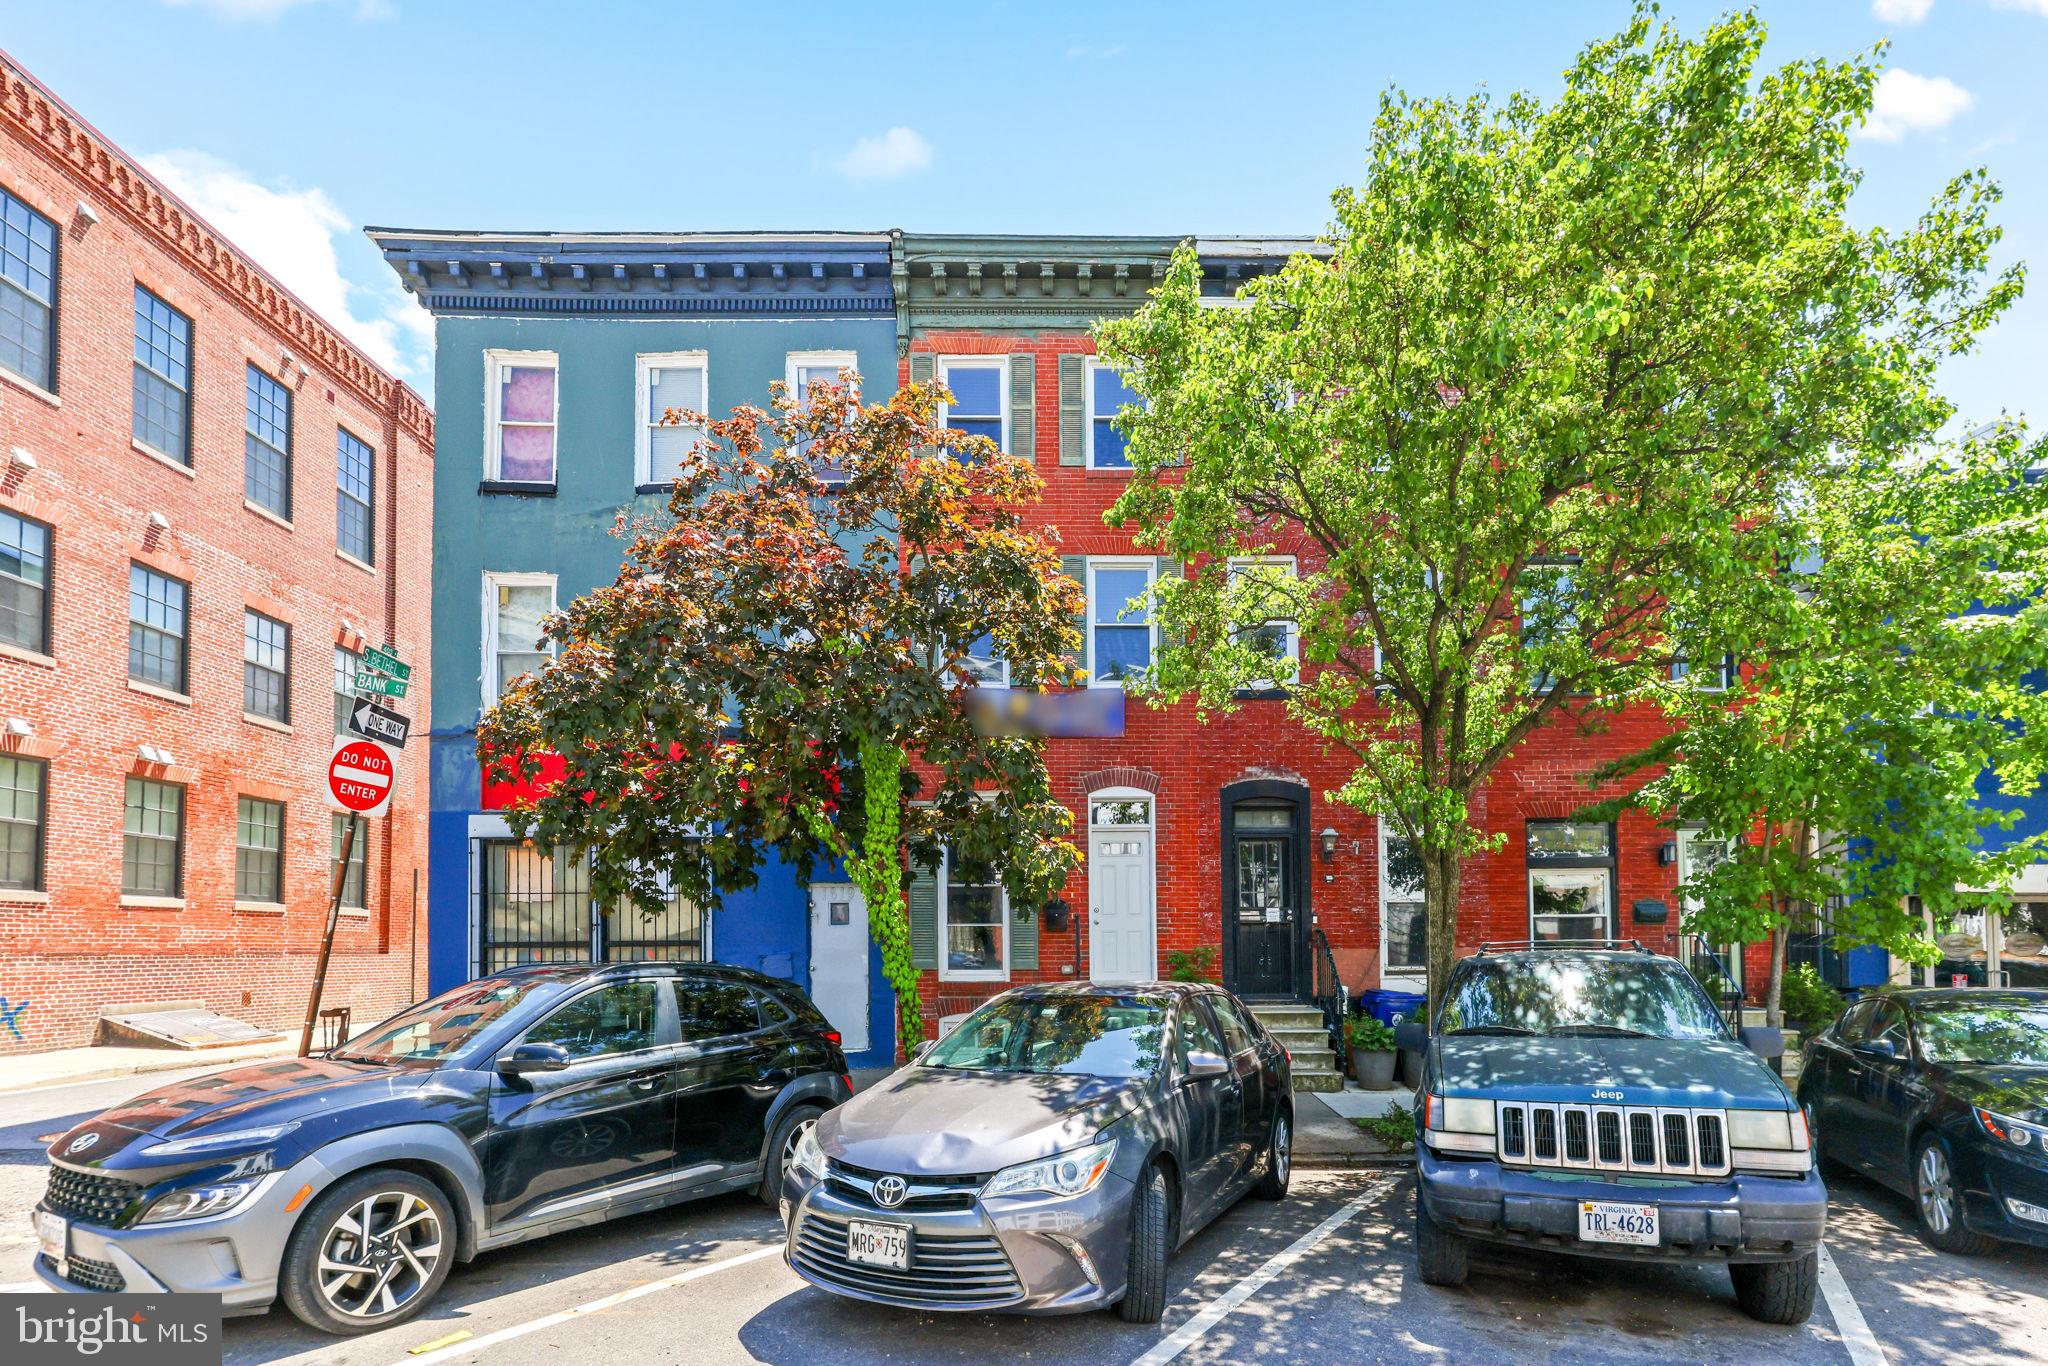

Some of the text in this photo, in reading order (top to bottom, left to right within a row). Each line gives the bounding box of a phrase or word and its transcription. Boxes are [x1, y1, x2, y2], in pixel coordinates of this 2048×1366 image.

[371, 652, 398, 676] BETHEL
[357, 674, 405, 695] BANK ST
[368, 713, 403, 738] ONE WAY
[341, 751, 388, 771] DO NOT
[339, 782, 377, 801] ENTER
[1591, 1089, 1624, 1101] Jeep
[1600, 1205, 1637, 1215] VIRGINIA
